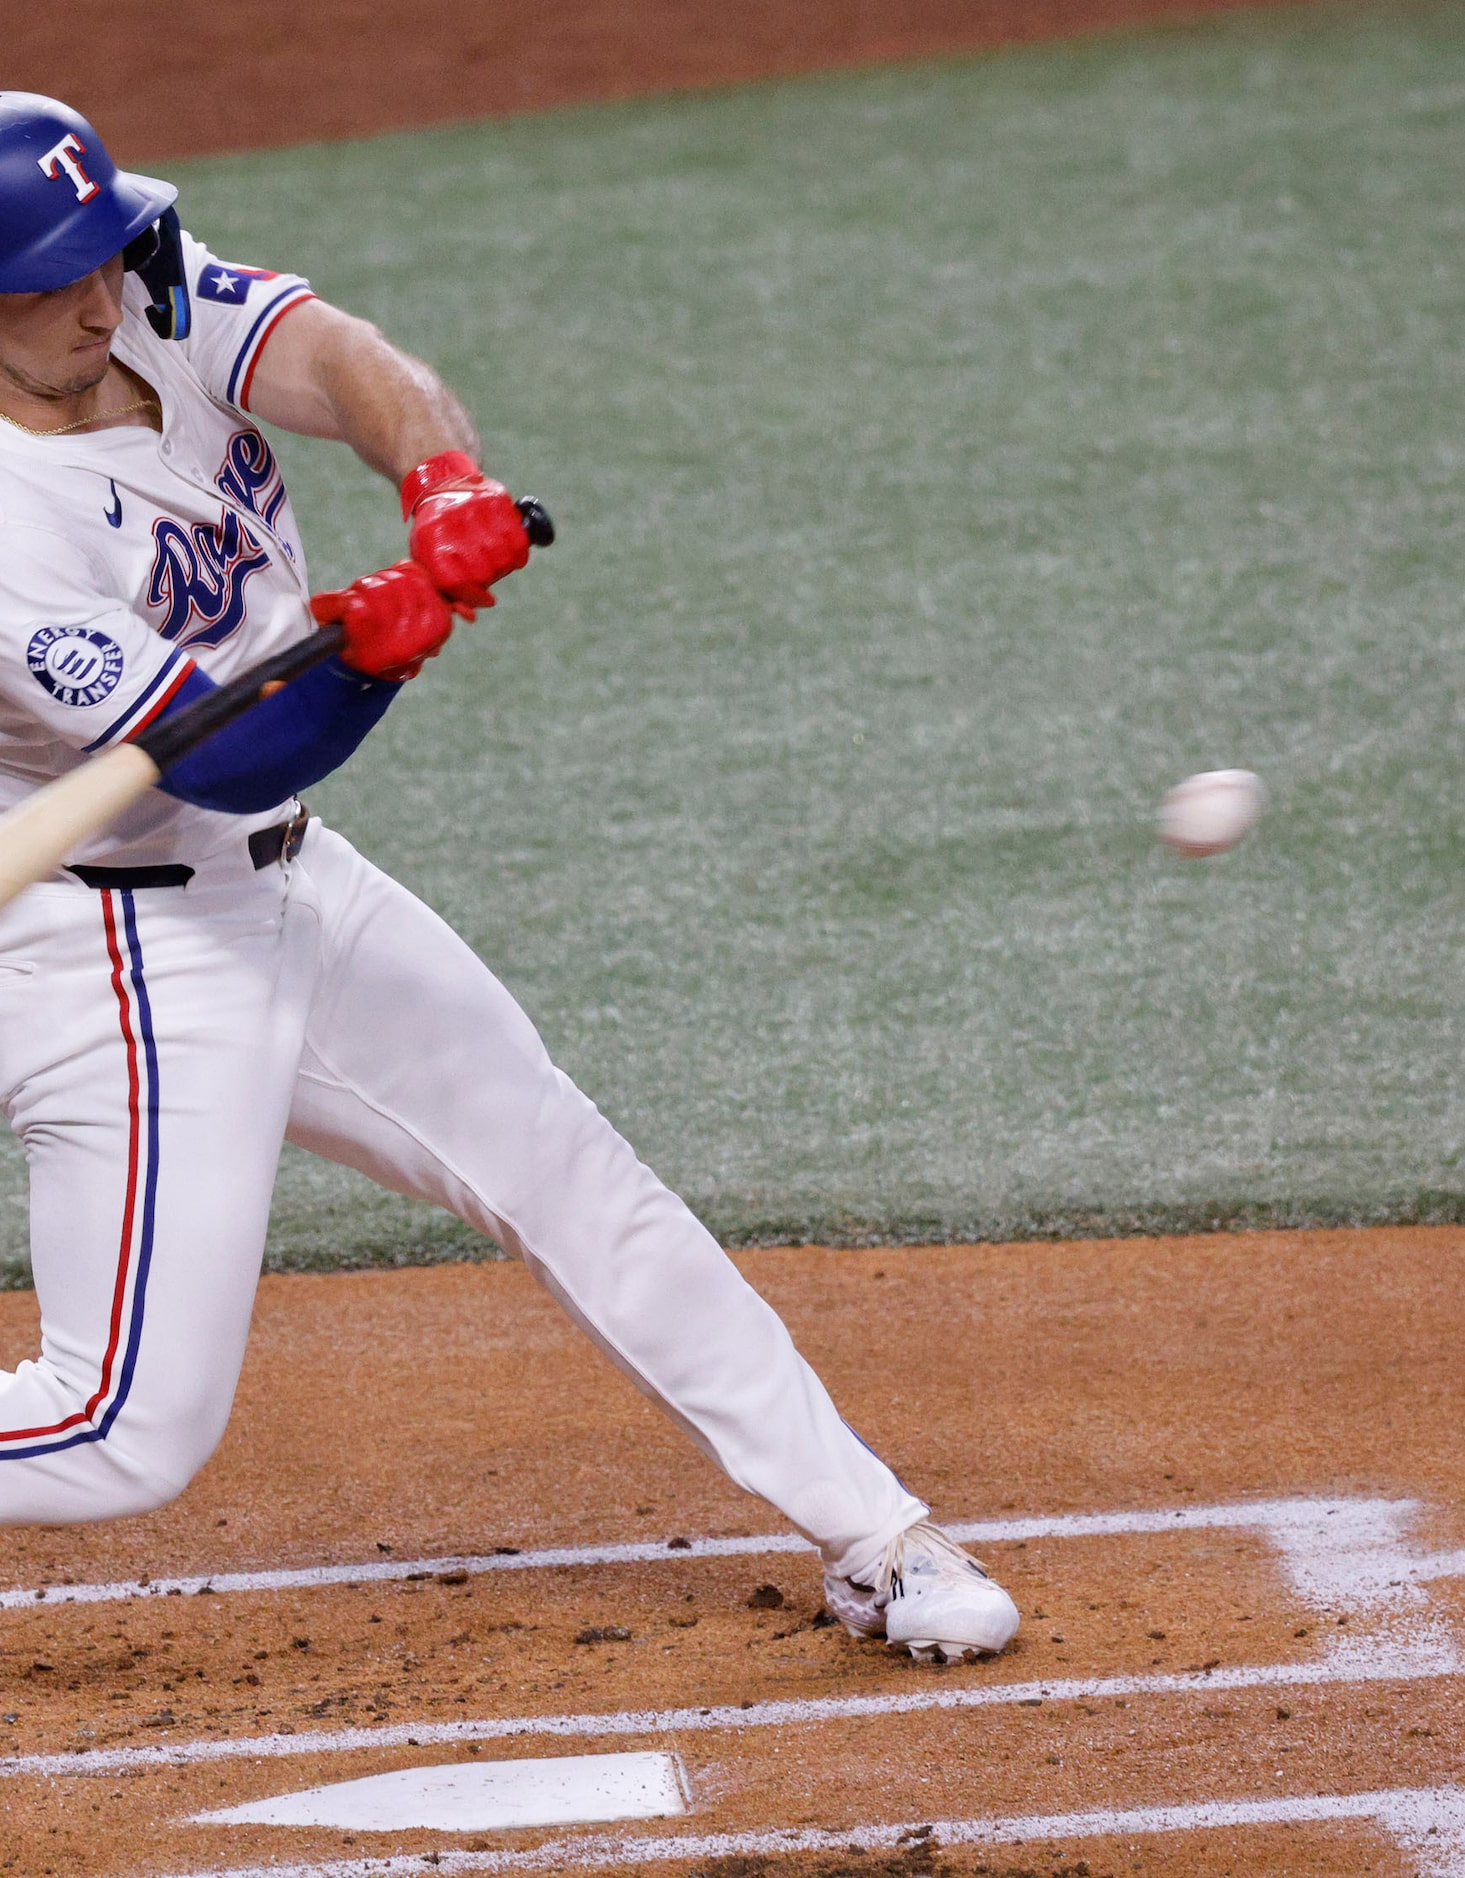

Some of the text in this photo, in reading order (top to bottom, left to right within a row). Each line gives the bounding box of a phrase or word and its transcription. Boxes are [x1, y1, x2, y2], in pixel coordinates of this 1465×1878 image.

[37, 133, 101, 204] T
[28, 627, 97, 672] ENERGY
[52, 640, 124, 707] TRANSFER
